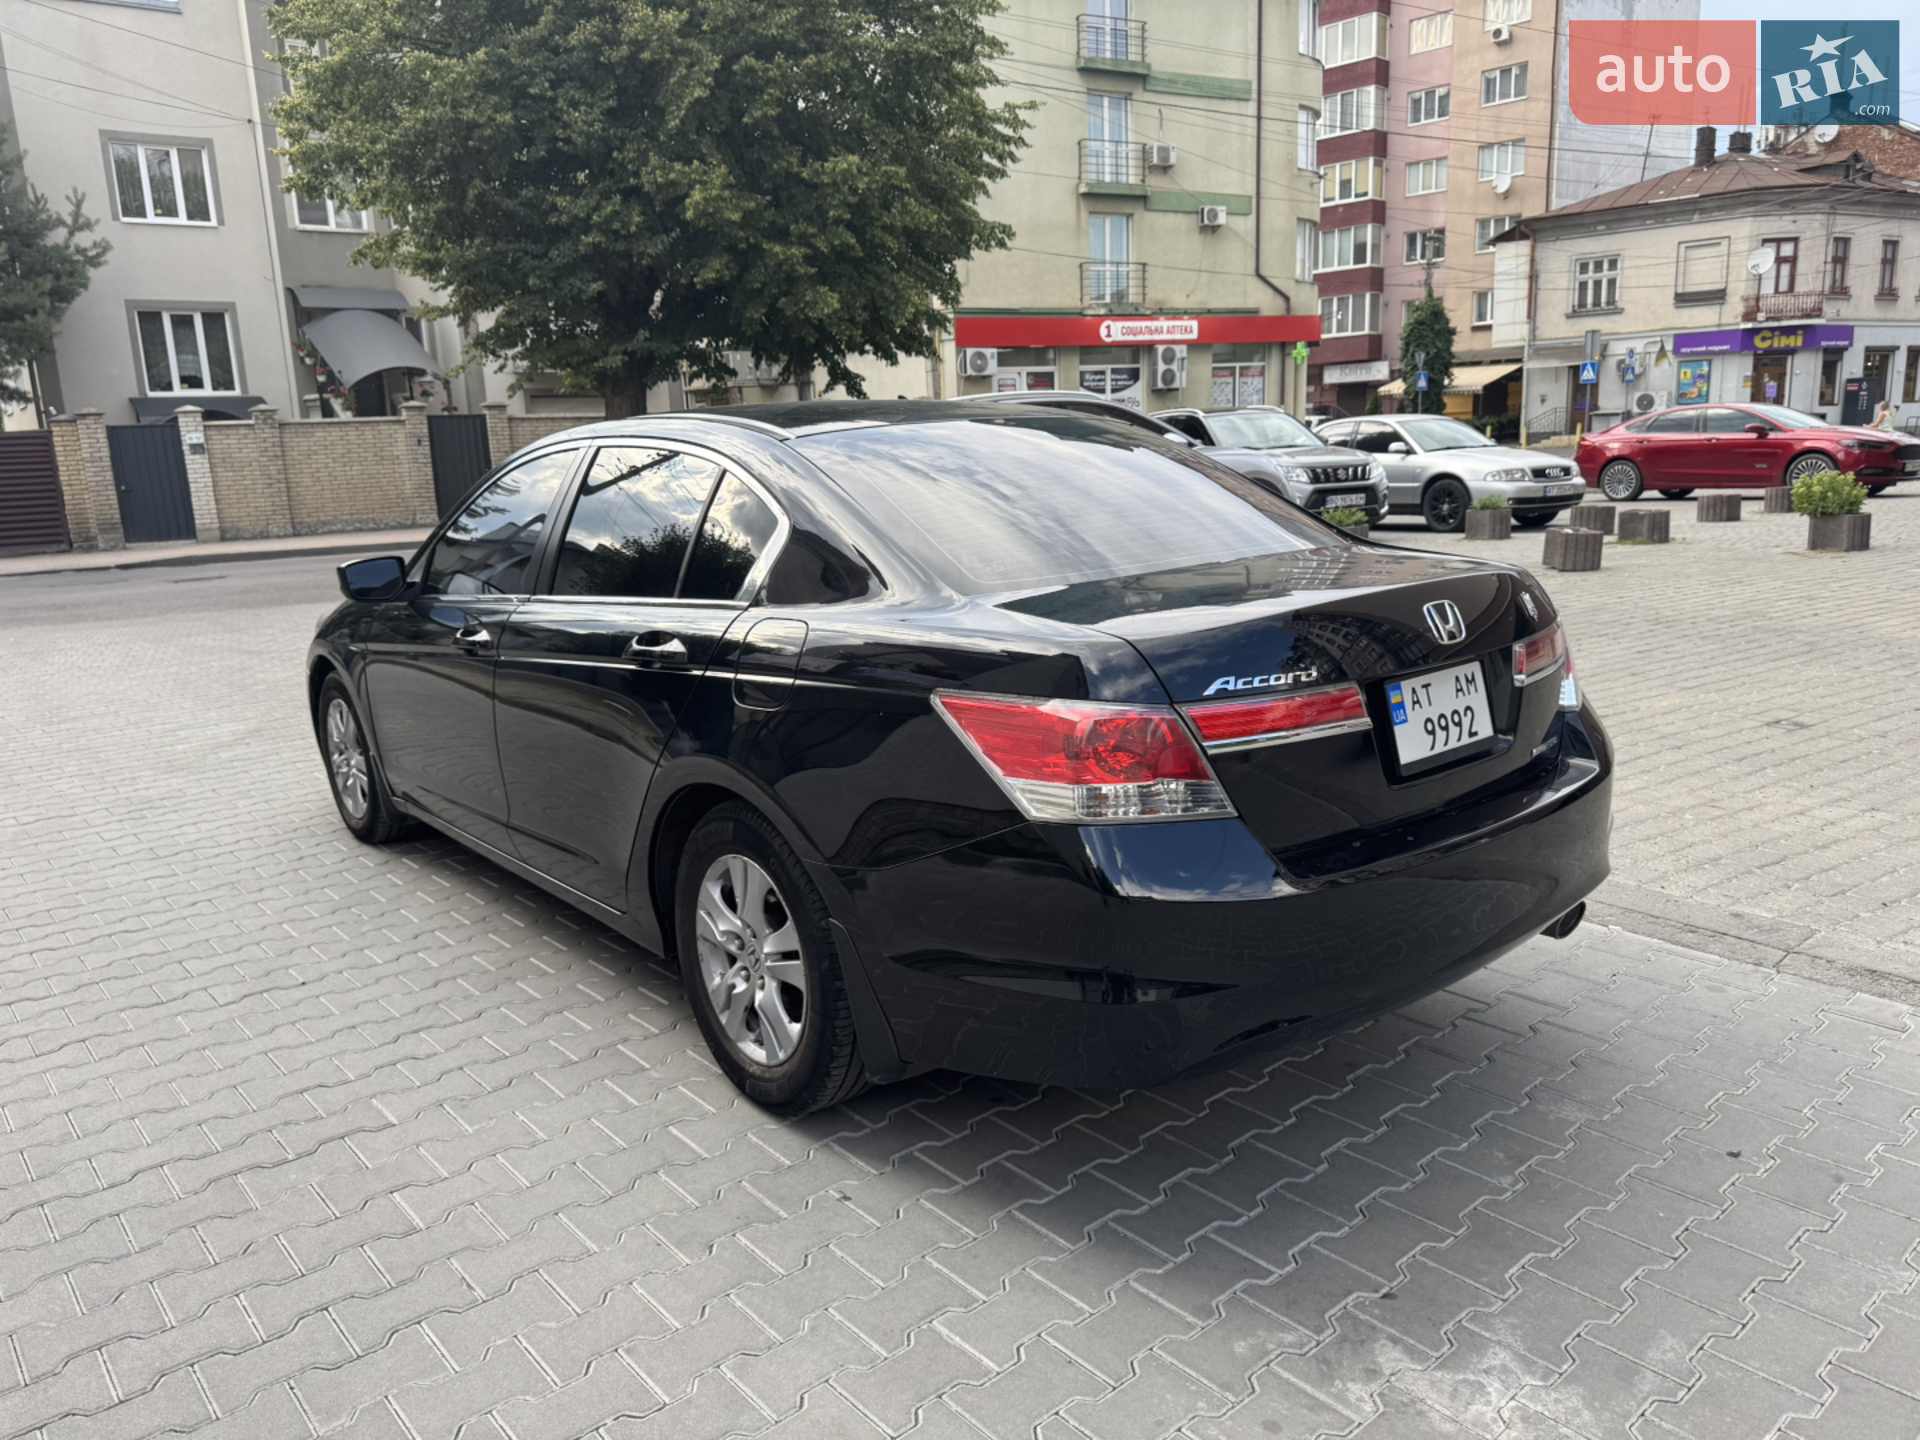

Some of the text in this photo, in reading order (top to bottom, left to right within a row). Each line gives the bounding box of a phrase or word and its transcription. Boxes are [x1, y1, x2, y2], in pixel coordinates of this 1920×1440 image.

[1104, 324, 1194, 338] 1 СОЦІАЛЬНА АПТЕКА
[1753, 330, 1804, 349] Сімі
[1203, 666, 1317, 696] Accord
[1411, 671, 1478, 712] AT AM
[1394, 709, 1406, 723] UA
[1424, 705, 1479, 752] 9992
